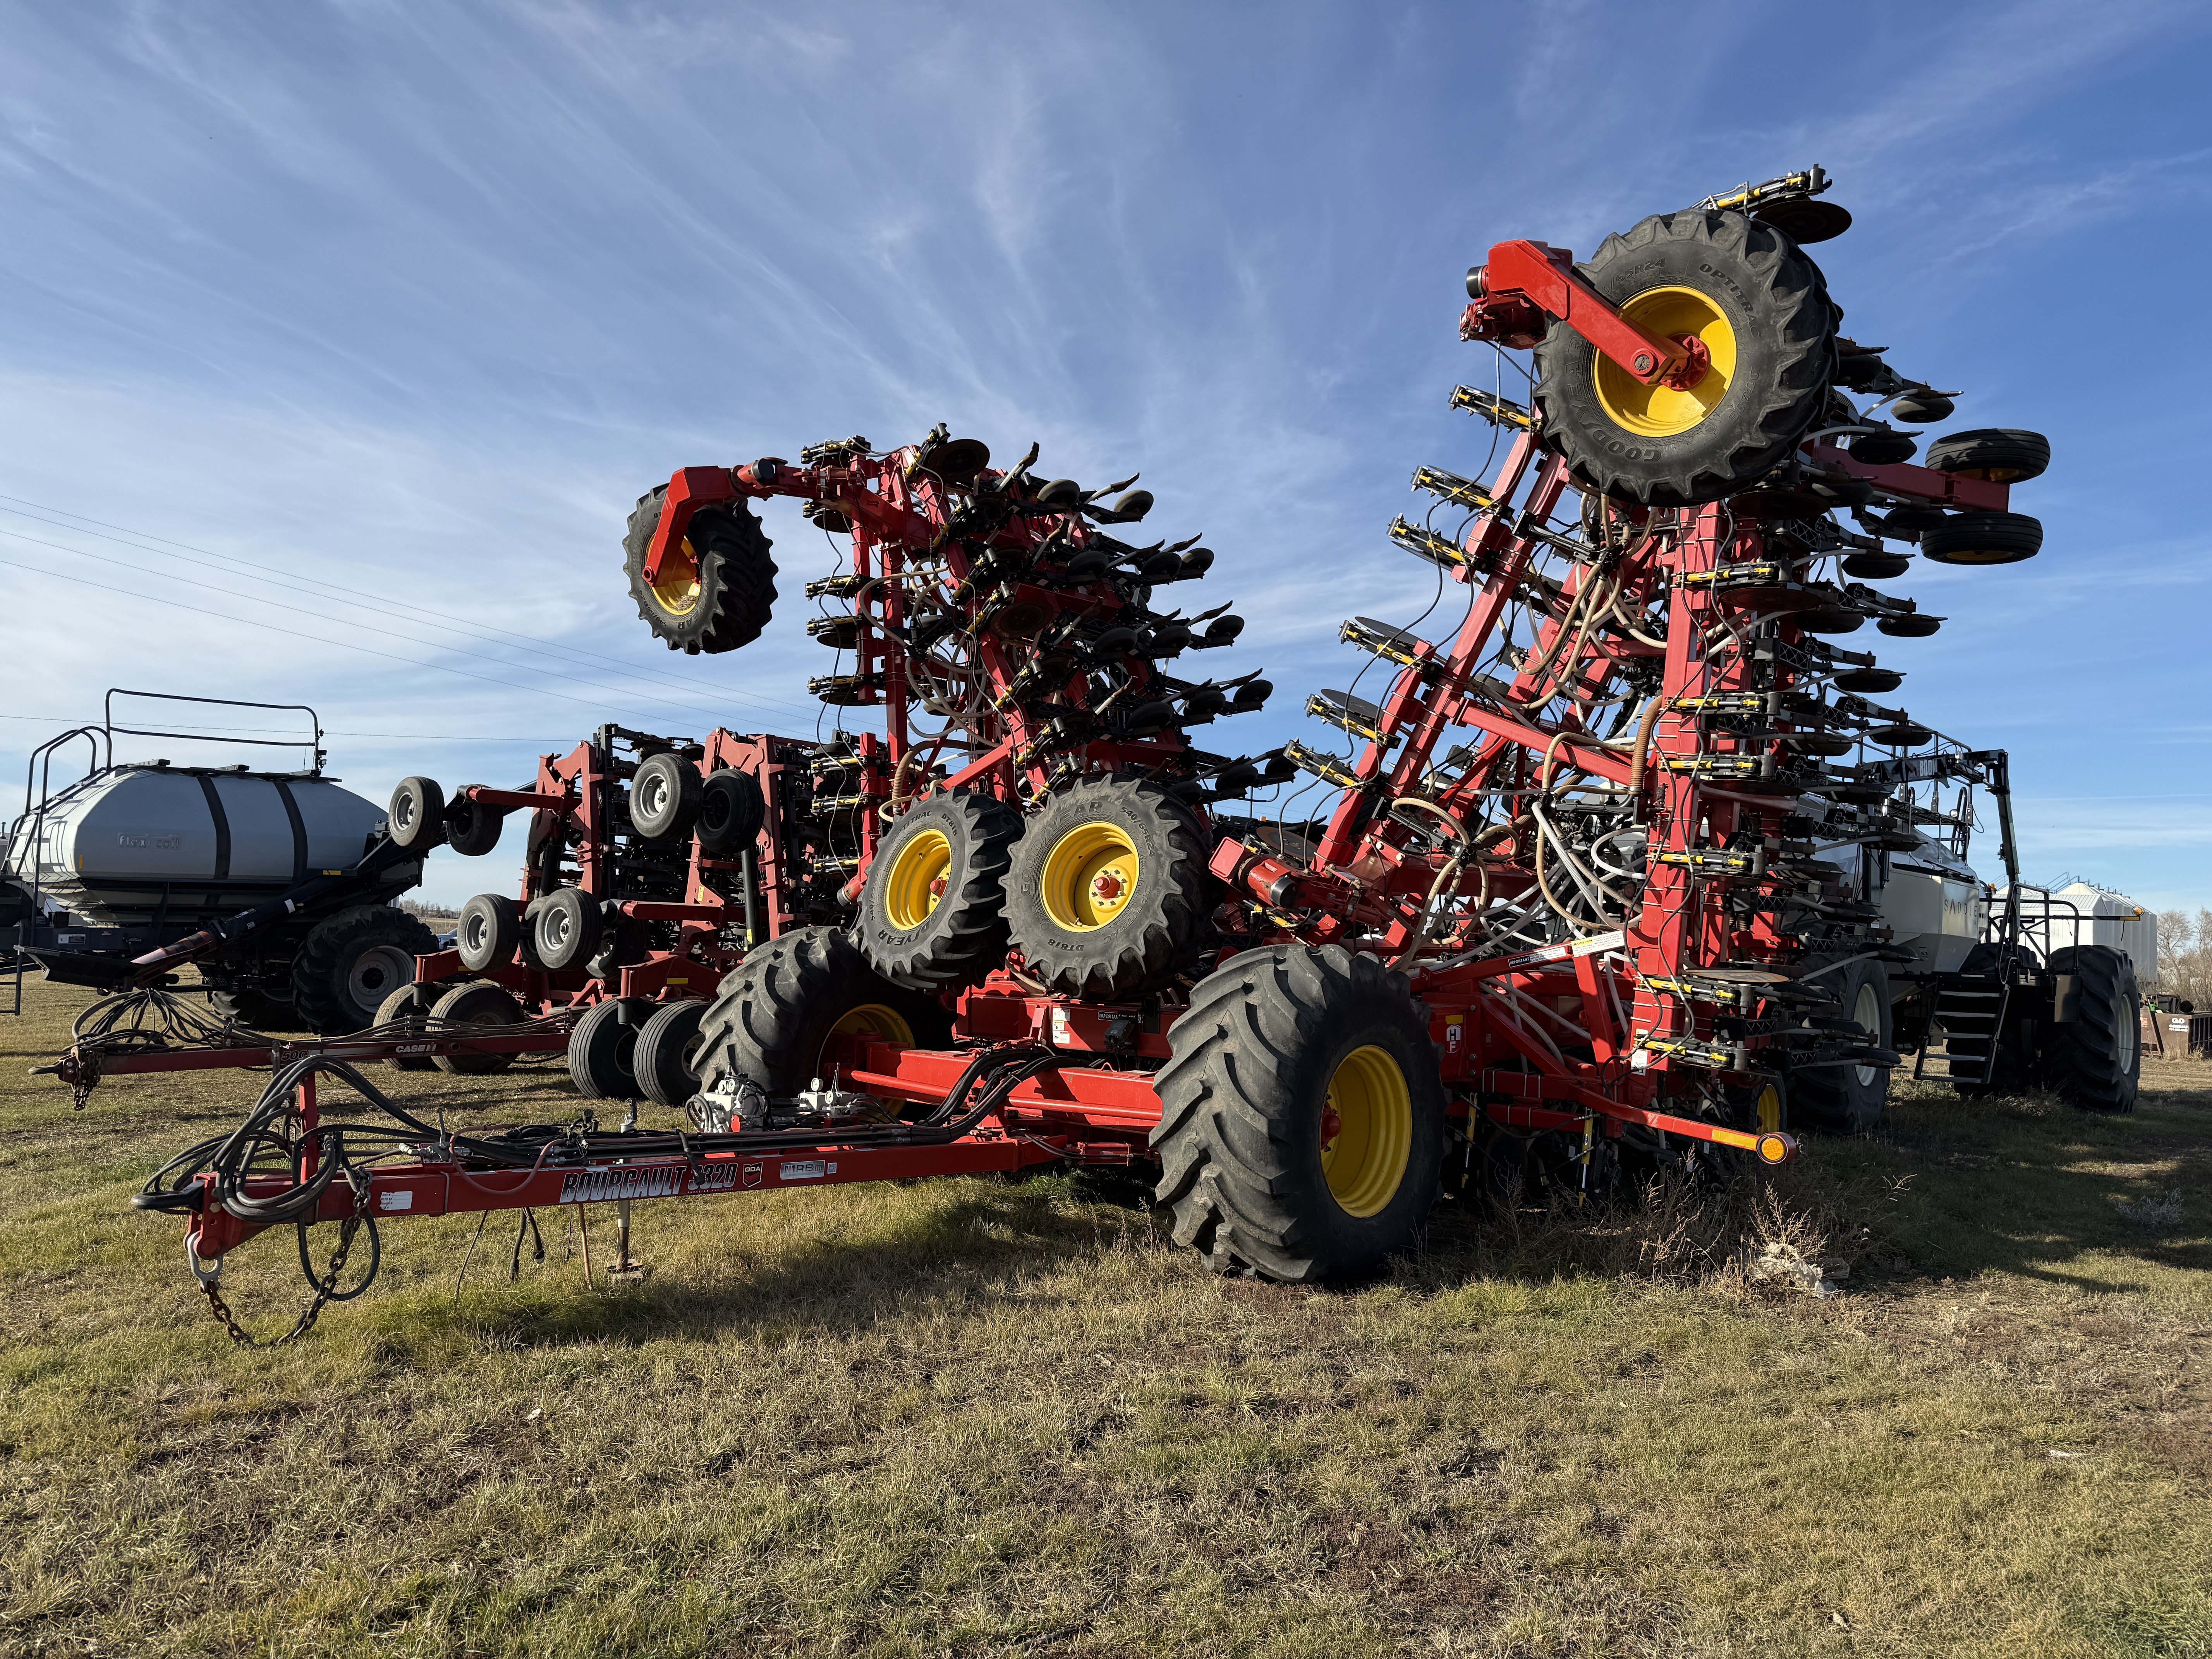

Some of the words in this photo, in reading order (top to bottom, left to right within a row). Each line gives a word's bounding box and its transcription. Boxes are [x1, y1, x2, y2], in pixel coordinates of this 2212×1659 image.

[1699, 264, 1761, 338] OPTITRAC
[1566, 336, 1662, 462] GOODYEAR
[941, 813, 958, 836] DT818
[1121, 806, 1156, 857] 540/65R24
[1021, 801, 1103, 896] GOODYEAR
[1103, 884, 1152, 944] OPTITRAC
[1048, 939, 1085, 952] DT818
[396, 1045, 426, 1053] CASE
[1449, 1029, 1456, 1041] H
[1450, 1041, 1456, 1052] F
[559, 1166, 687, 1203] BOURGAULT
